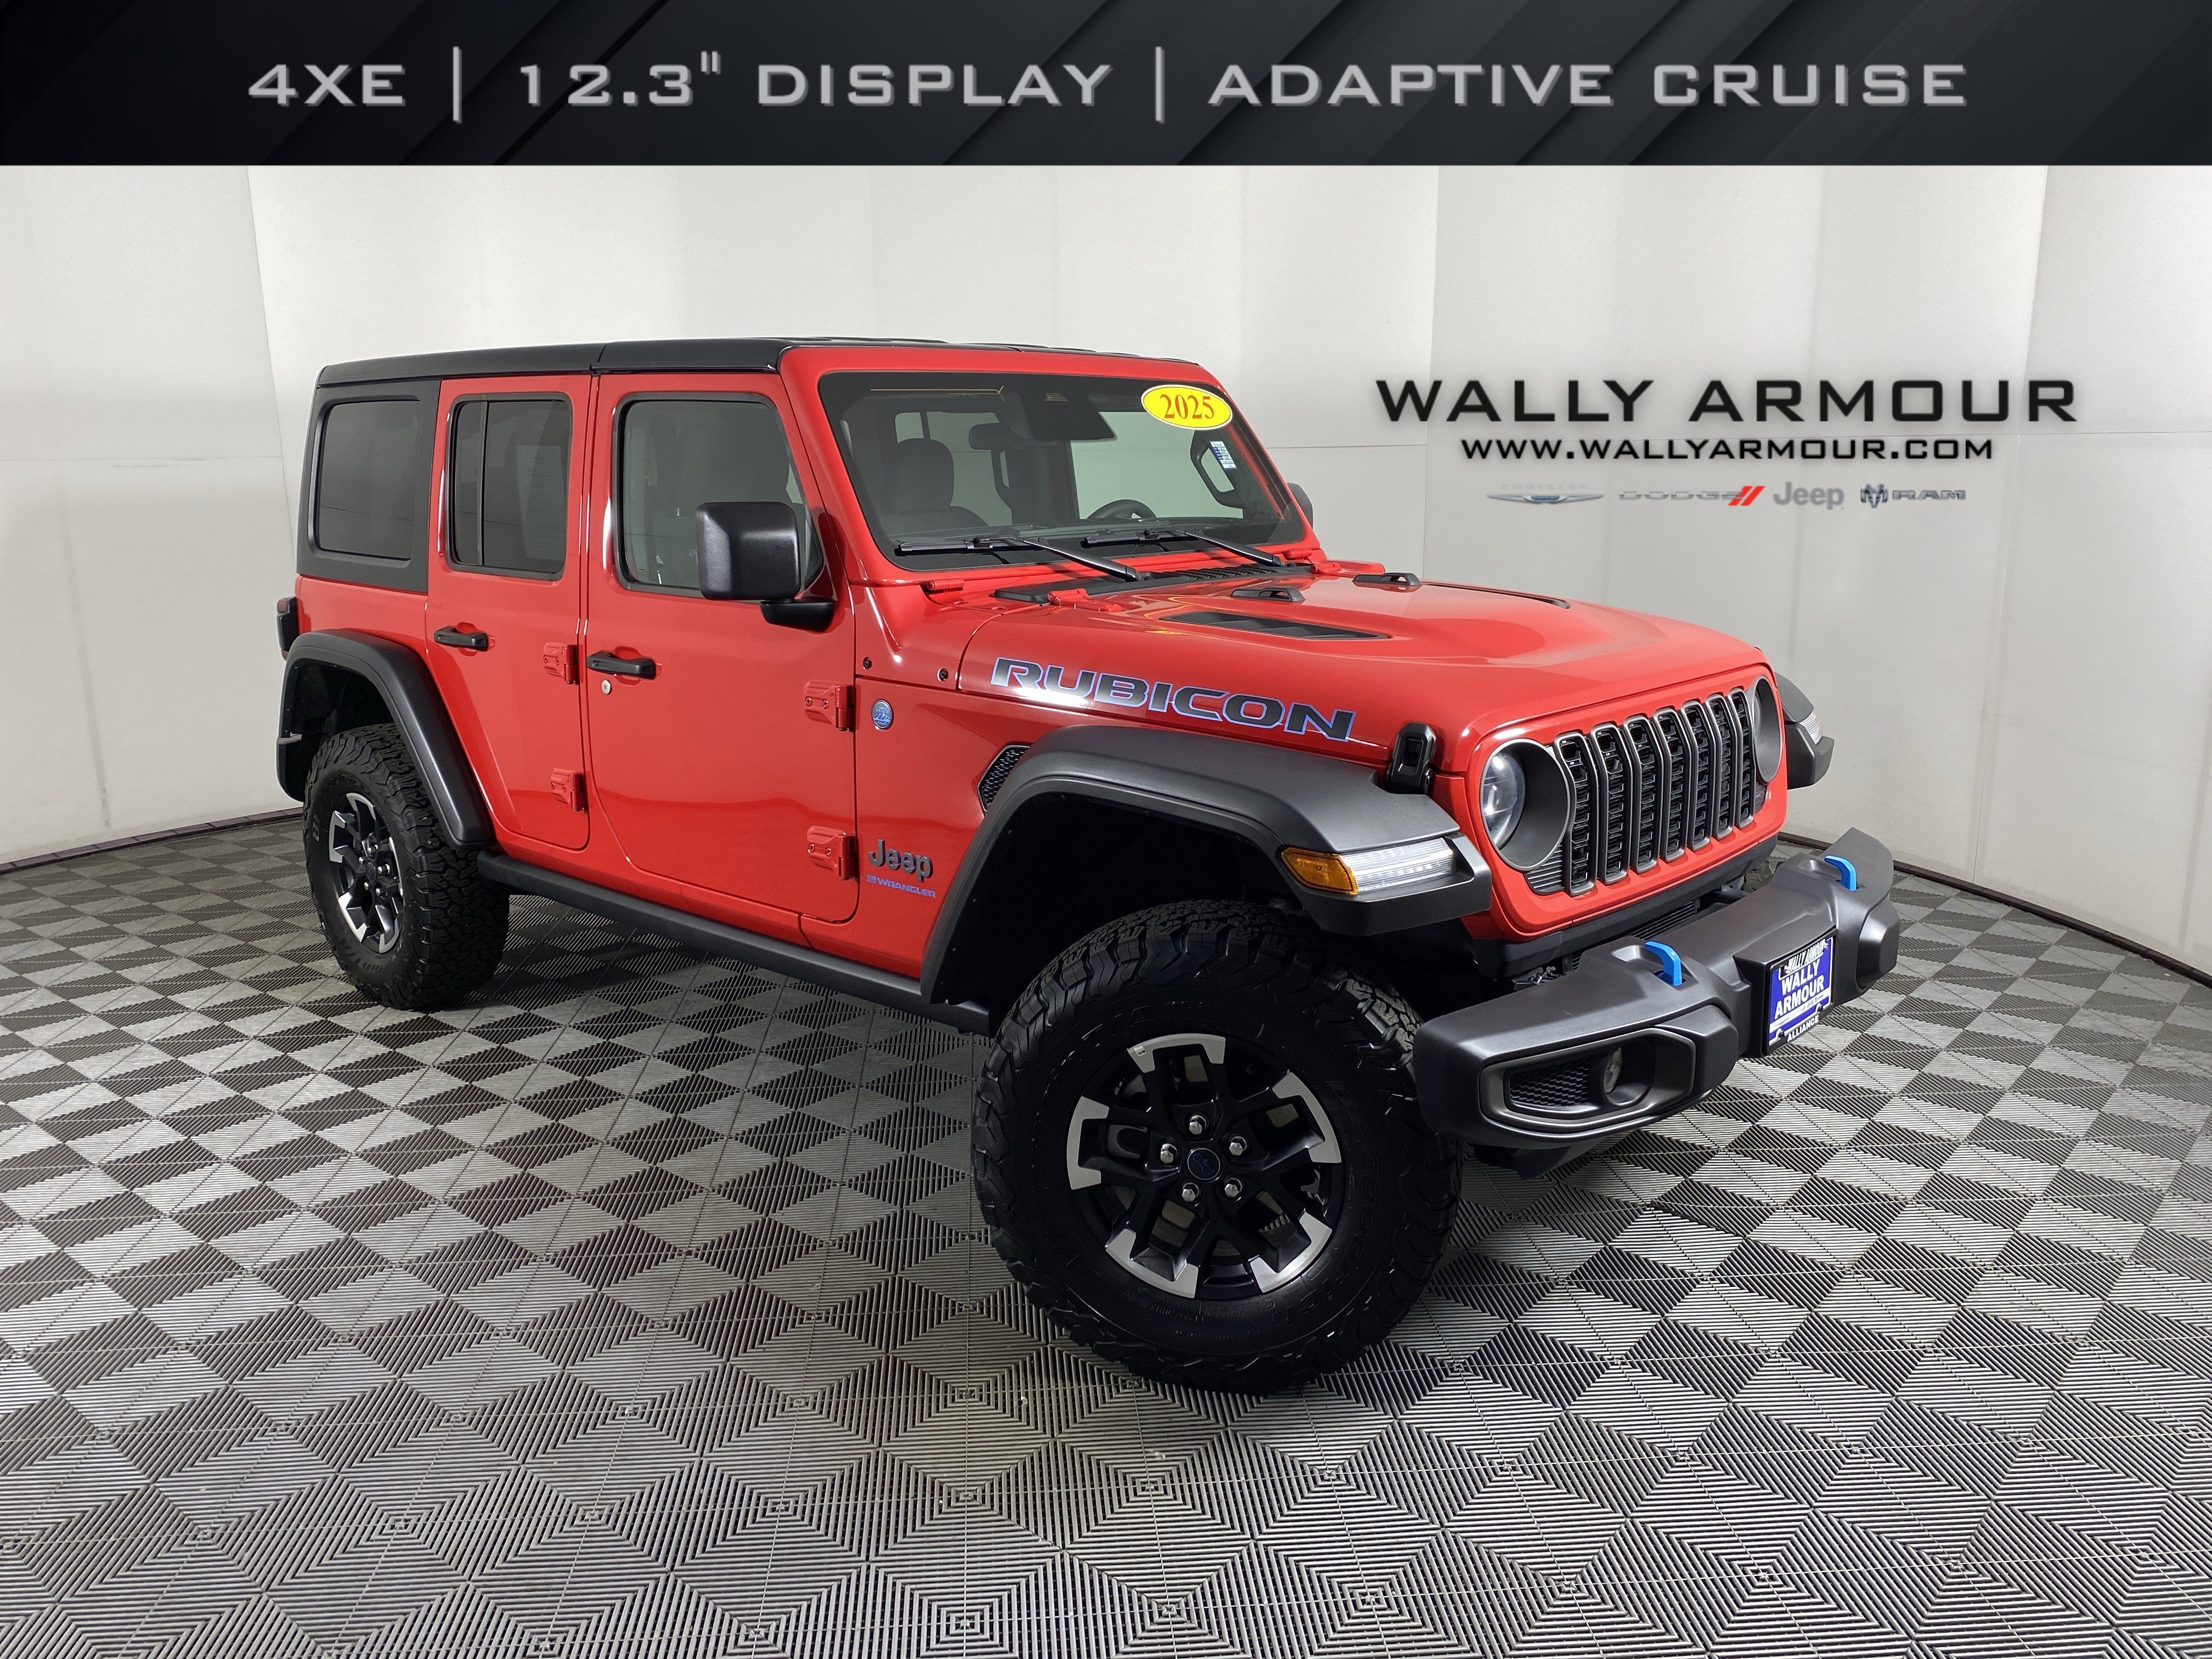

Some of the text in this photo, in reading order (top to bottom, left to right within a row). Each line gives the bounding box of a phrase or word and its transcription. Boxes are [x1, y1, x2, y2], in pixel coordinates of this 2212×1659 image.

[1160, 394, 1215, 419] 2025
[991, 657, 1356, 742] RUBICON
[868, 839, 933, 882] Jeep
[876, 876, 936, 899] WRANGLER
[1781, 958, 1821, 996] WALLY
[1774, 974, 1825, 1020] ARMOUR
[1787, 1014, 1820, 1043] ALLIANCE
